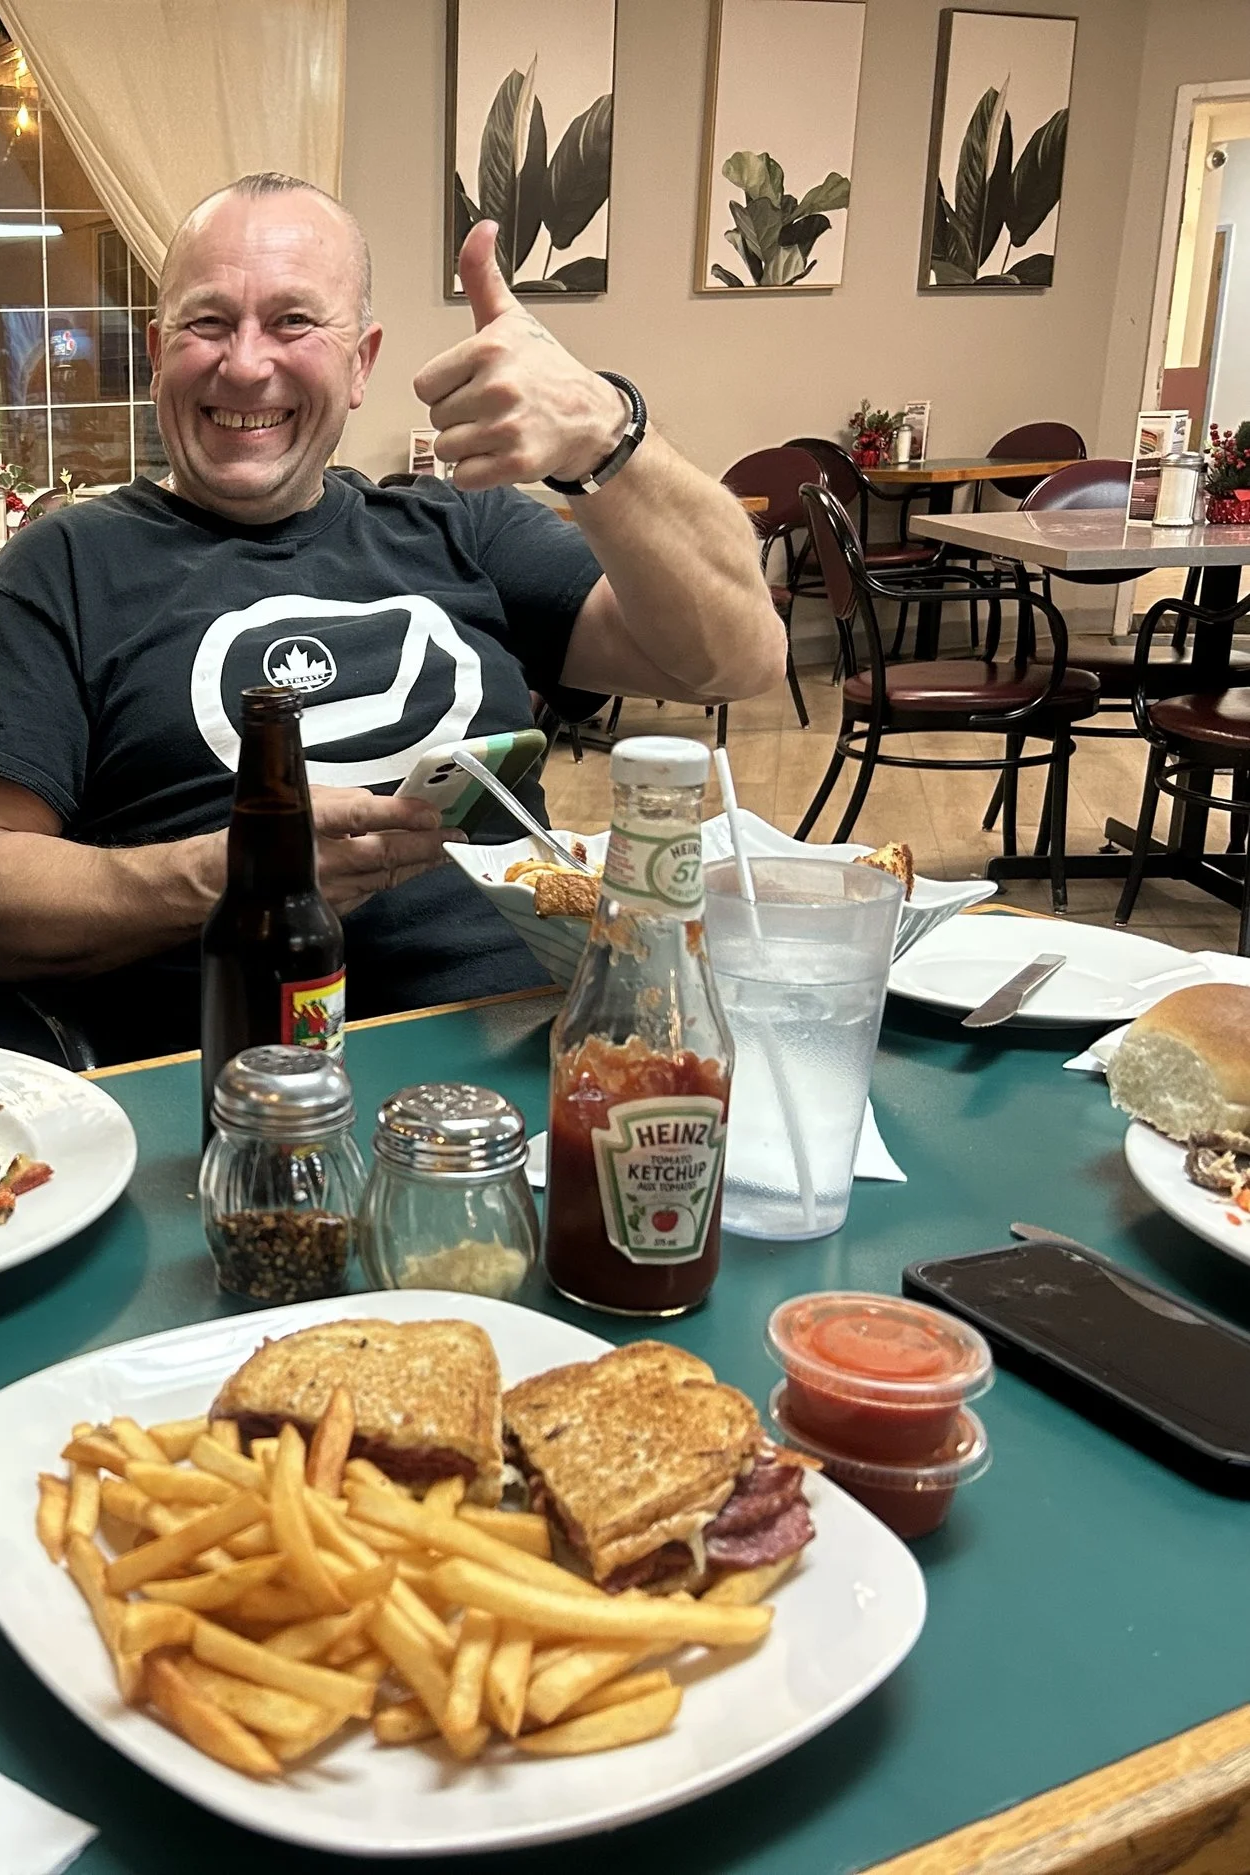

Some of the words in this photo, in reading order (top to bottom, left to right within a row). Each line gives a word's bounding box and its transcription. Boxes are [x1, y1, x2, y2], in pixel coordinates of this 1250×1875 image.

[671, 860, 700, 883] 57
[636, 1123, 709, 1148] HEINZ
[651, 1154, 692, 1165] TOMATO
[628, 1161, 707, 1182] KETCHUP
